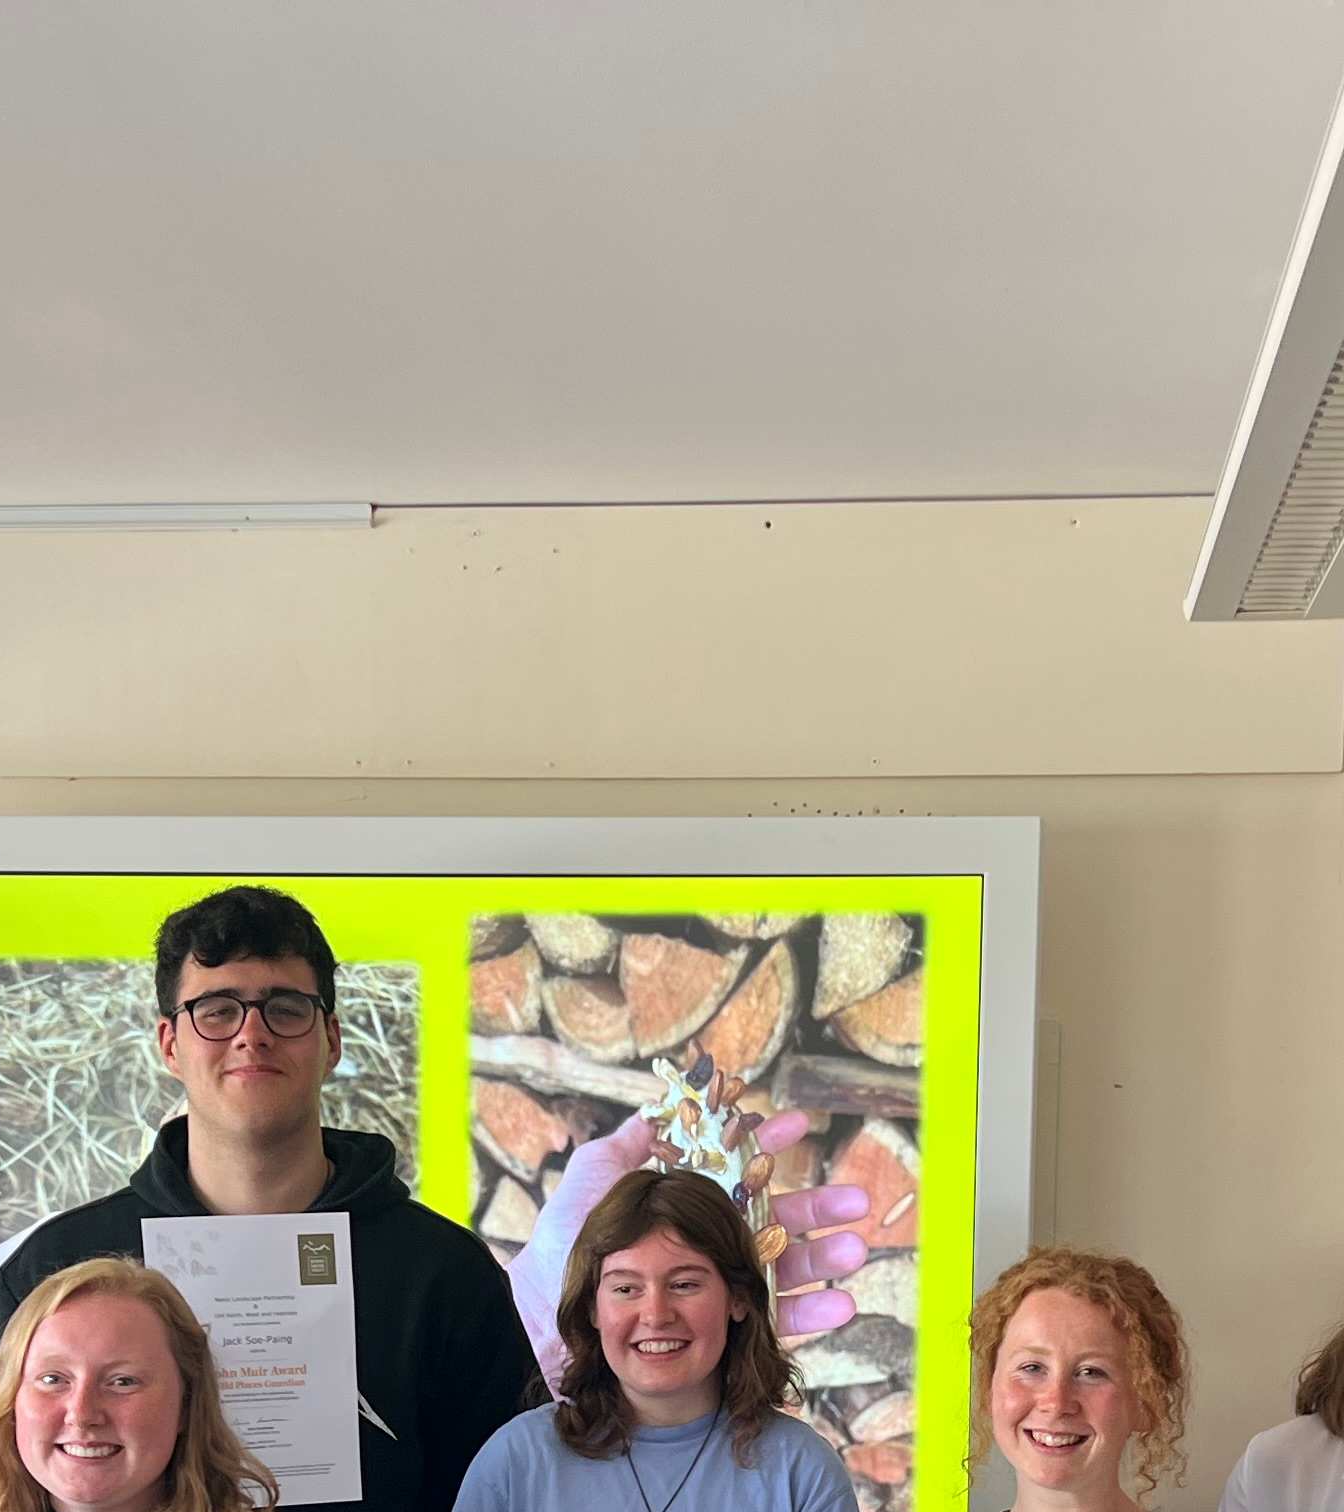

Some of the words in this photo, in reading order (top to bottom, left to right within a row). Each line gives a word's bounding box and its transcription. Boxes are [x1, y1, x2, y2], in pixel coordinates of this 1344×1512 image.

[222, 1336, 242, 1346] Jack
[215, 1367, 237, 1379] ohn
[240, 1365, 268, 1377] Muir
[269, 1363, 306, 1375] Award
[218, 1381, 233, 1389] ild
[235, 1379, 263, 1388] Places
